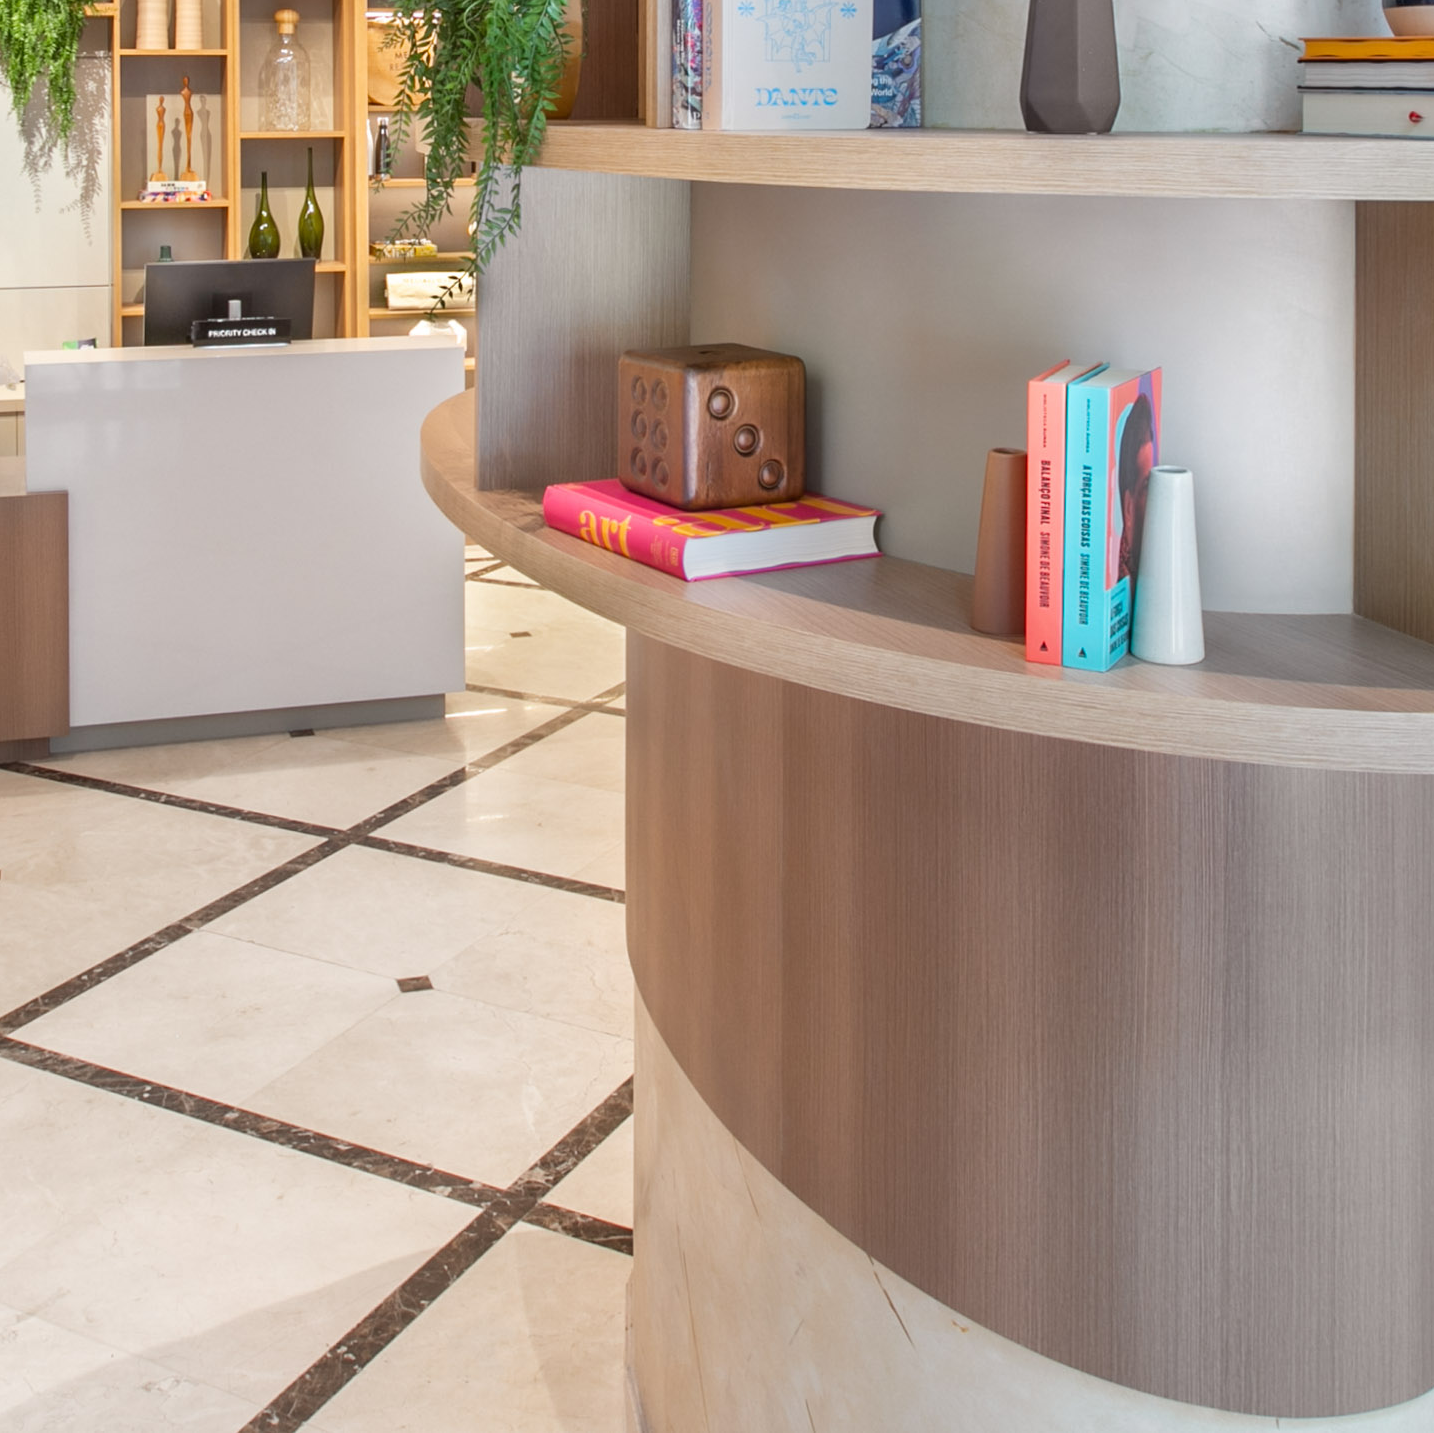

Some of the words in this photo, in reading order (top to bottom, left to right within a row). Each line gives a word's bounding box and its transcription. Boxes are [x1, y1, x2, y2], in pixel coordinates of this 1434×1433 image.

[755, 86, 839, 107] DANTE
[208, 329, 242, 337] PRIORITY
[242, 328, 268, 337] CHECK
[1038, 459, 1051, 499] BALANÇO
[1080, 471, 1092, 499] FORÇA
[1040, 501, 1051, 525] FINAL
[1081, 499, 1092, 517] DAS
[579, 509, 632, 558] art
[1039, 531, 1051, 559] SIMONE
[1080, 516, 1091, 548] COISAS
[1039, 560, 1050, 571] DE
[1079, 552, 1090, 579] SIMONE
[1039, 571, 1050, 608] BEAUVOIR
[1079, 580, 1090, 590] DE
[1078, 590, 1089, 625] BEAUVOIR
